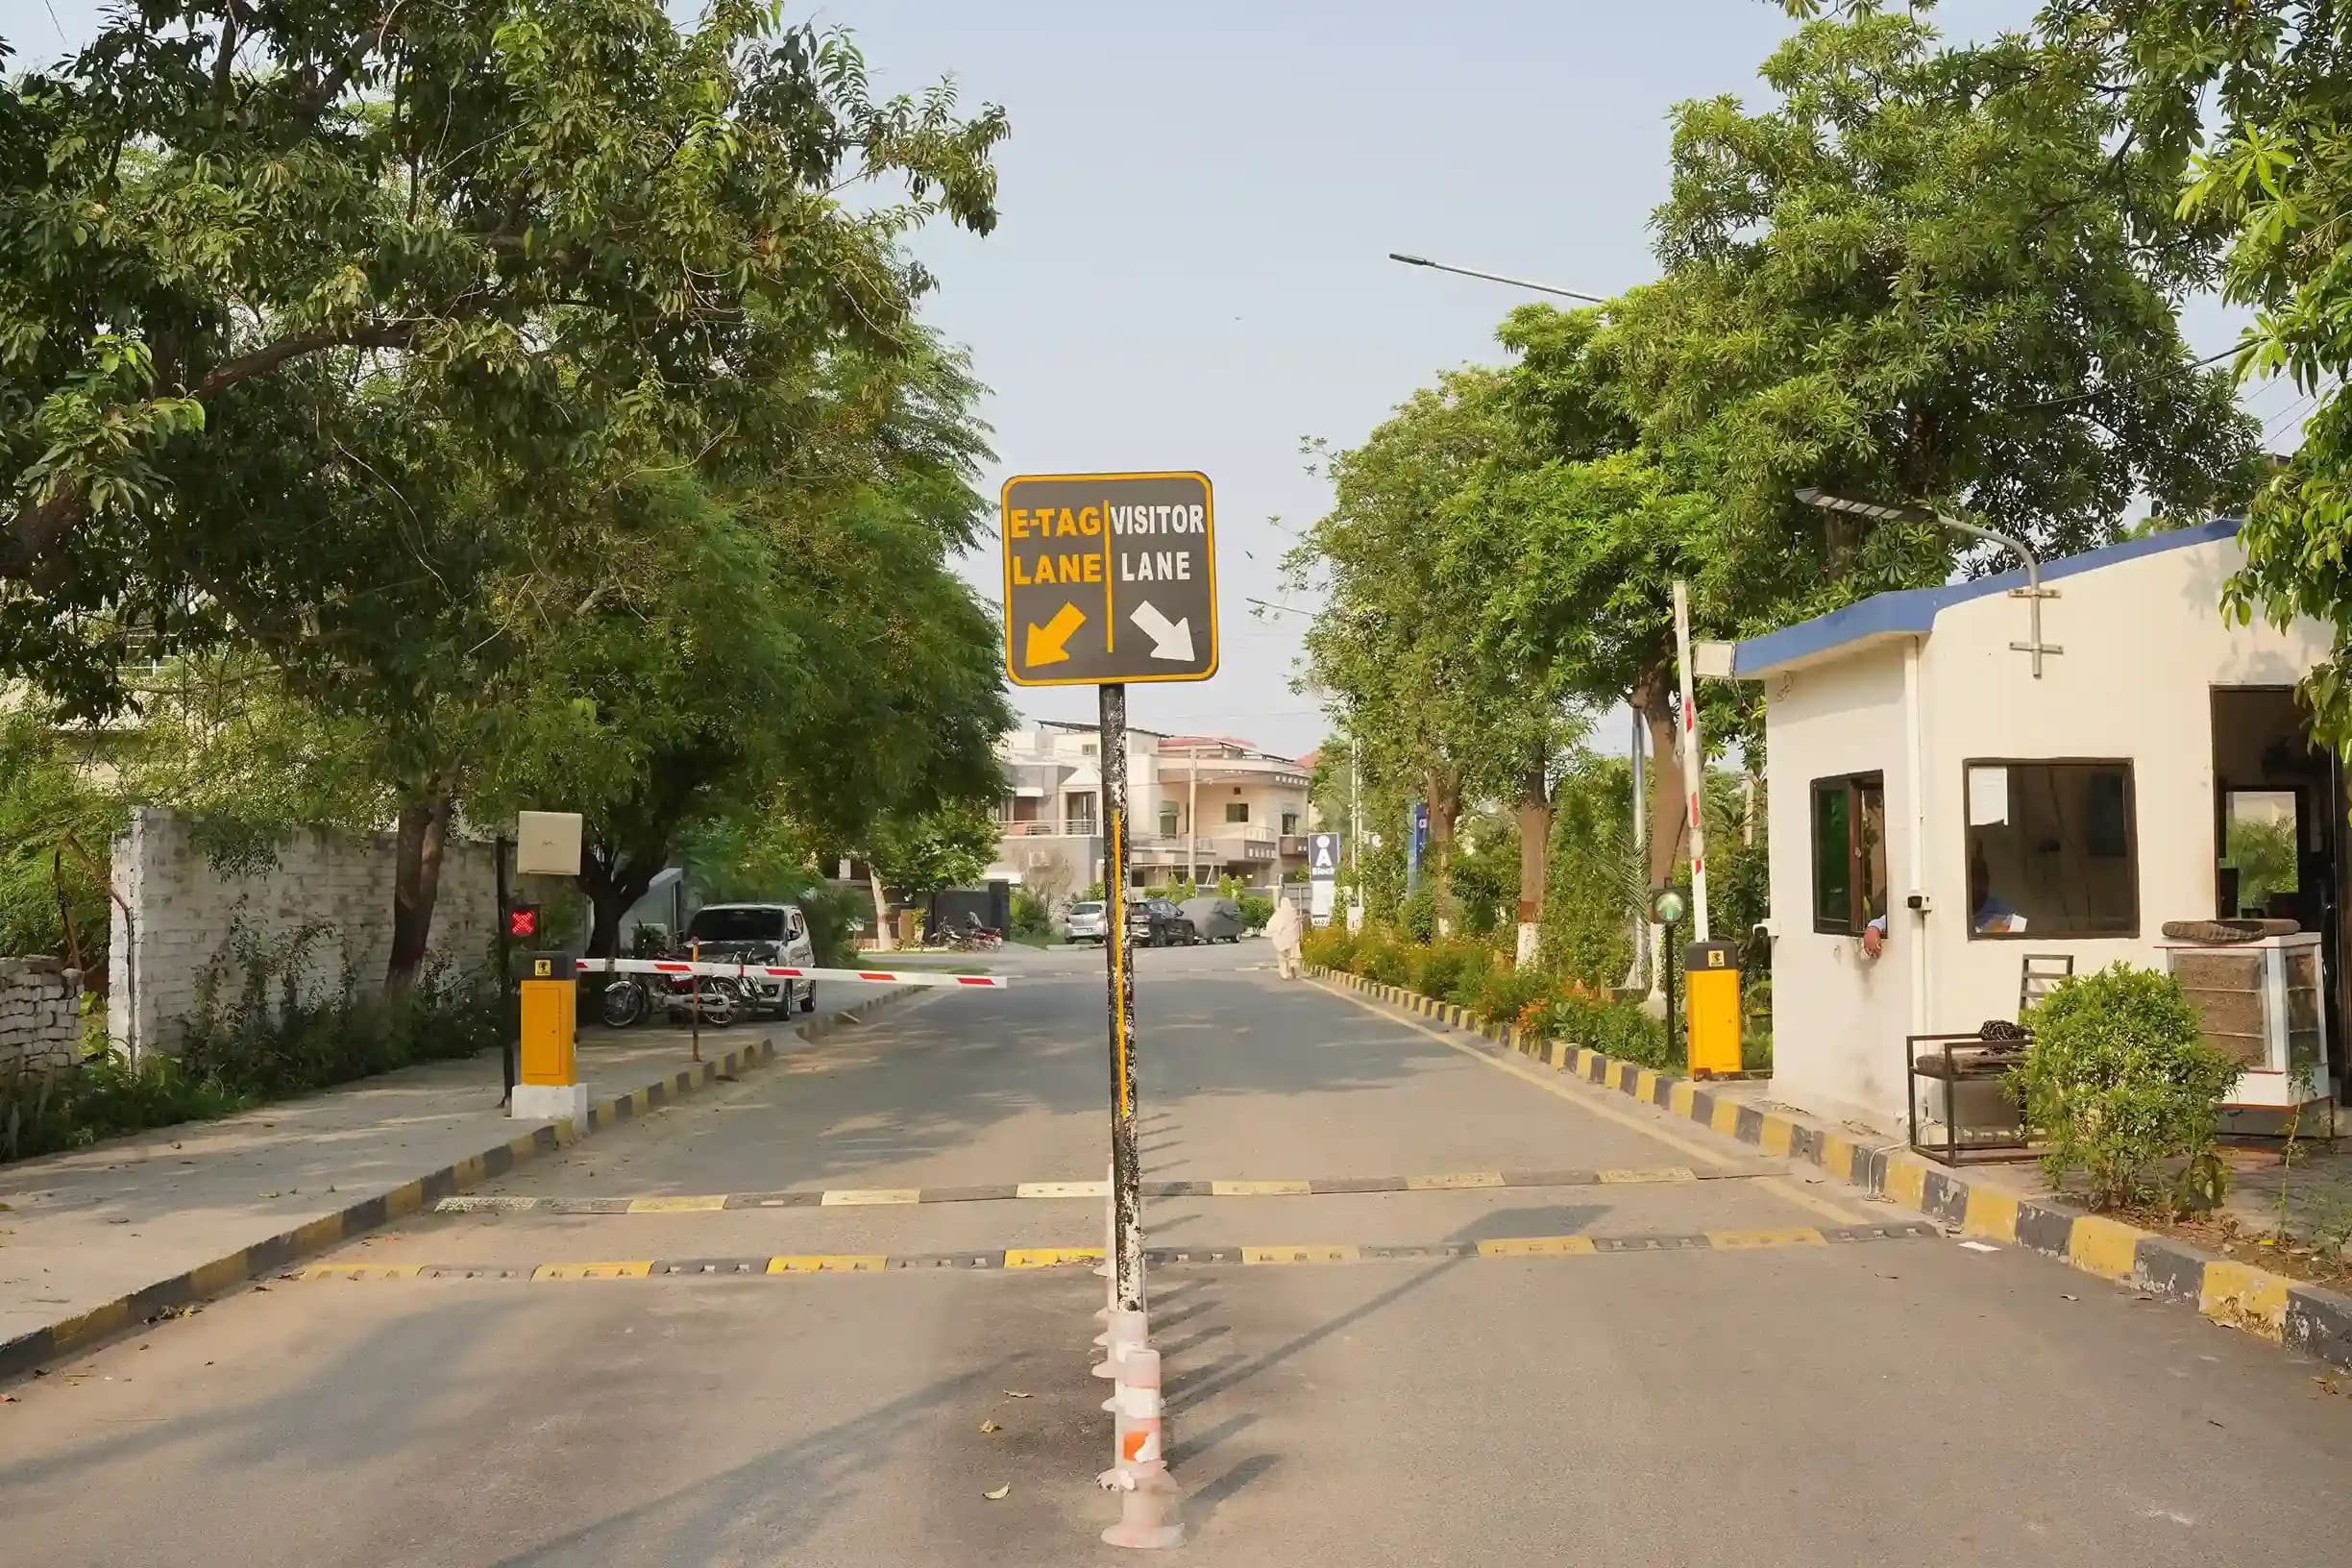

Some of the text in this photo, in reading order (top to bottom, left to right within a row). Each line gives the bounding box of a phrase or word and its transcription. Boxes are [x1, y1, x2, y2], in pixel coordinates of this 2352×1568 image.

[1011, 506, 1101, 538] E-TAG
[1110, 504, 1205, 535] VISITOR
[1014, 553, 1102, 585] LANE
[1121, 551, 1190, 581] LANE
[1315, 847, 1333, 867] A
